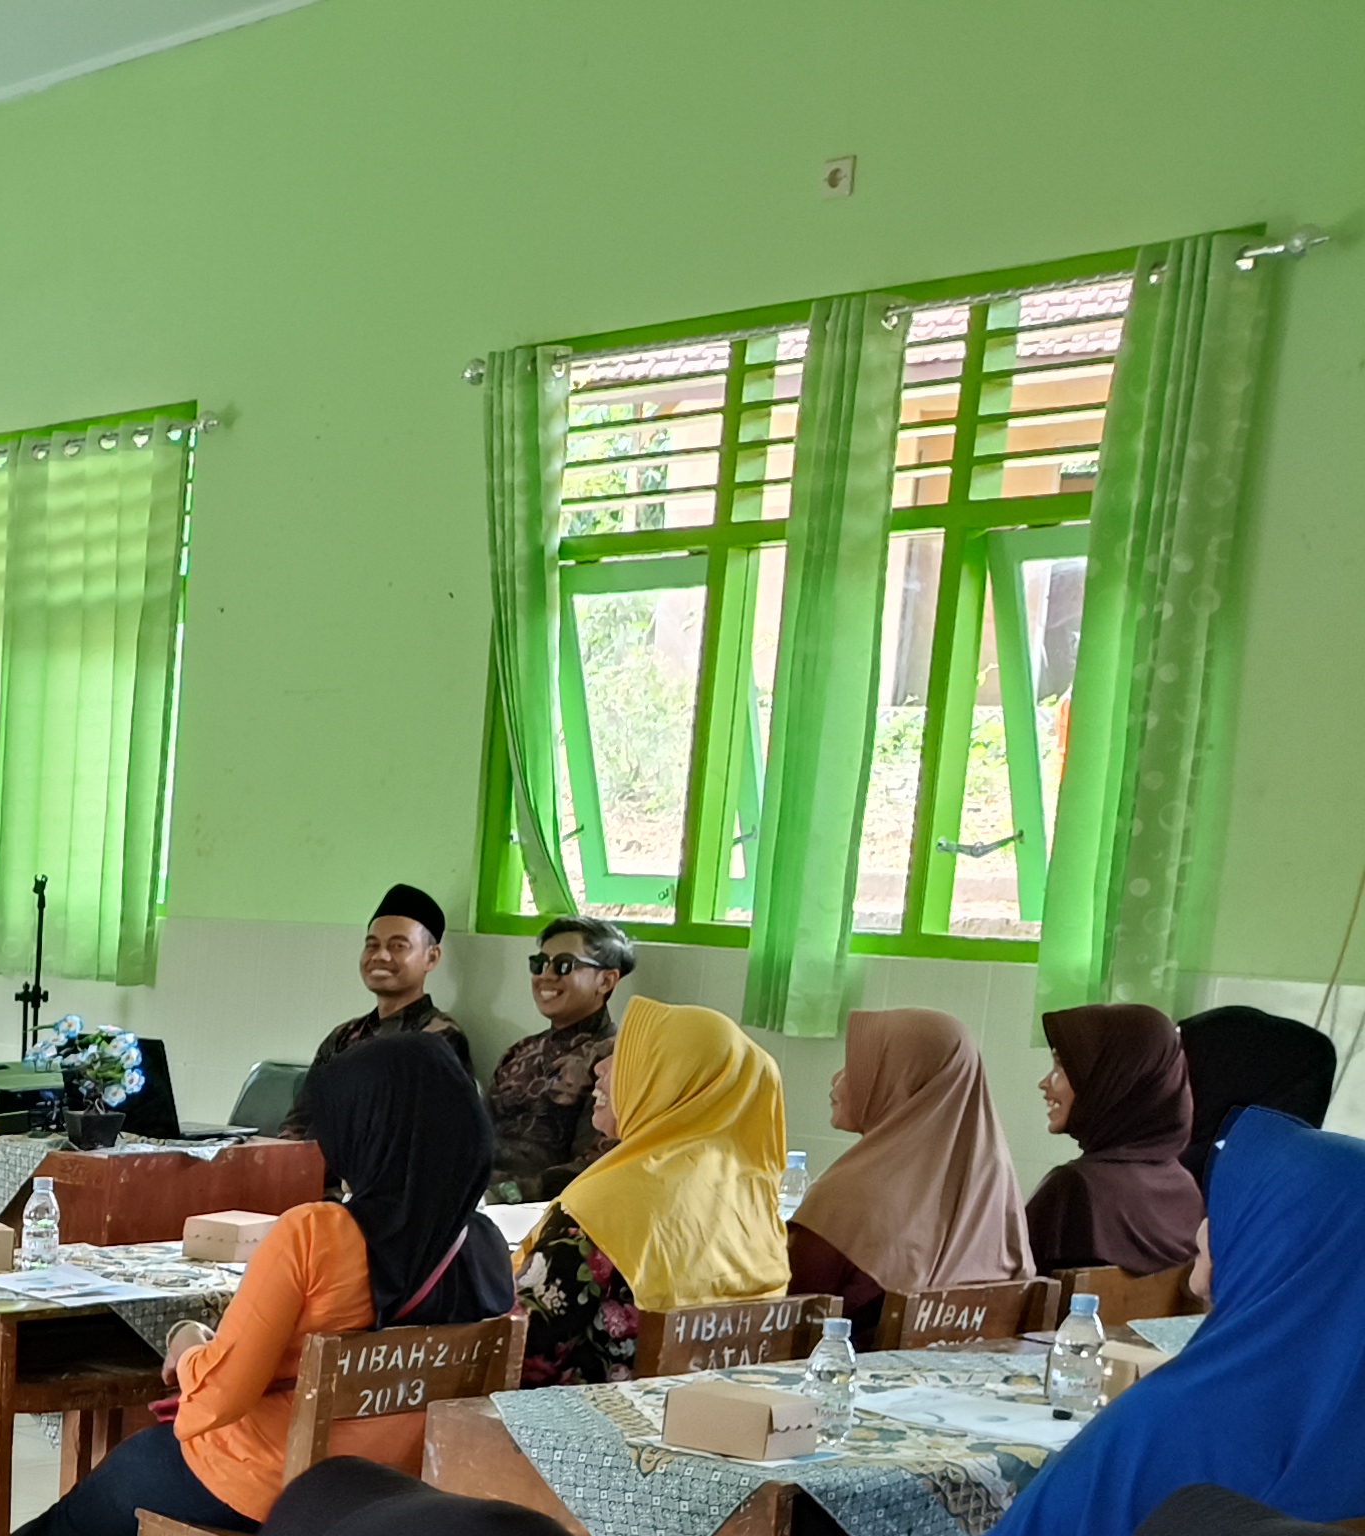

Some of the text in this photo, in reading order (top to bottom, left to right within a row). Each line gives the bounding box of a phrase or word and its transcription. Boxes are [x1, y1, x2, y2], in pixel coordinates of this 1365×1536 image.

[675, 1309, 752, 1343] HIBAH
[914, 1299, 987, 1333] HIBAH
[337, 1342, 425, 1375] HIBAH
[357, 1378, 425, 1416] 2013
